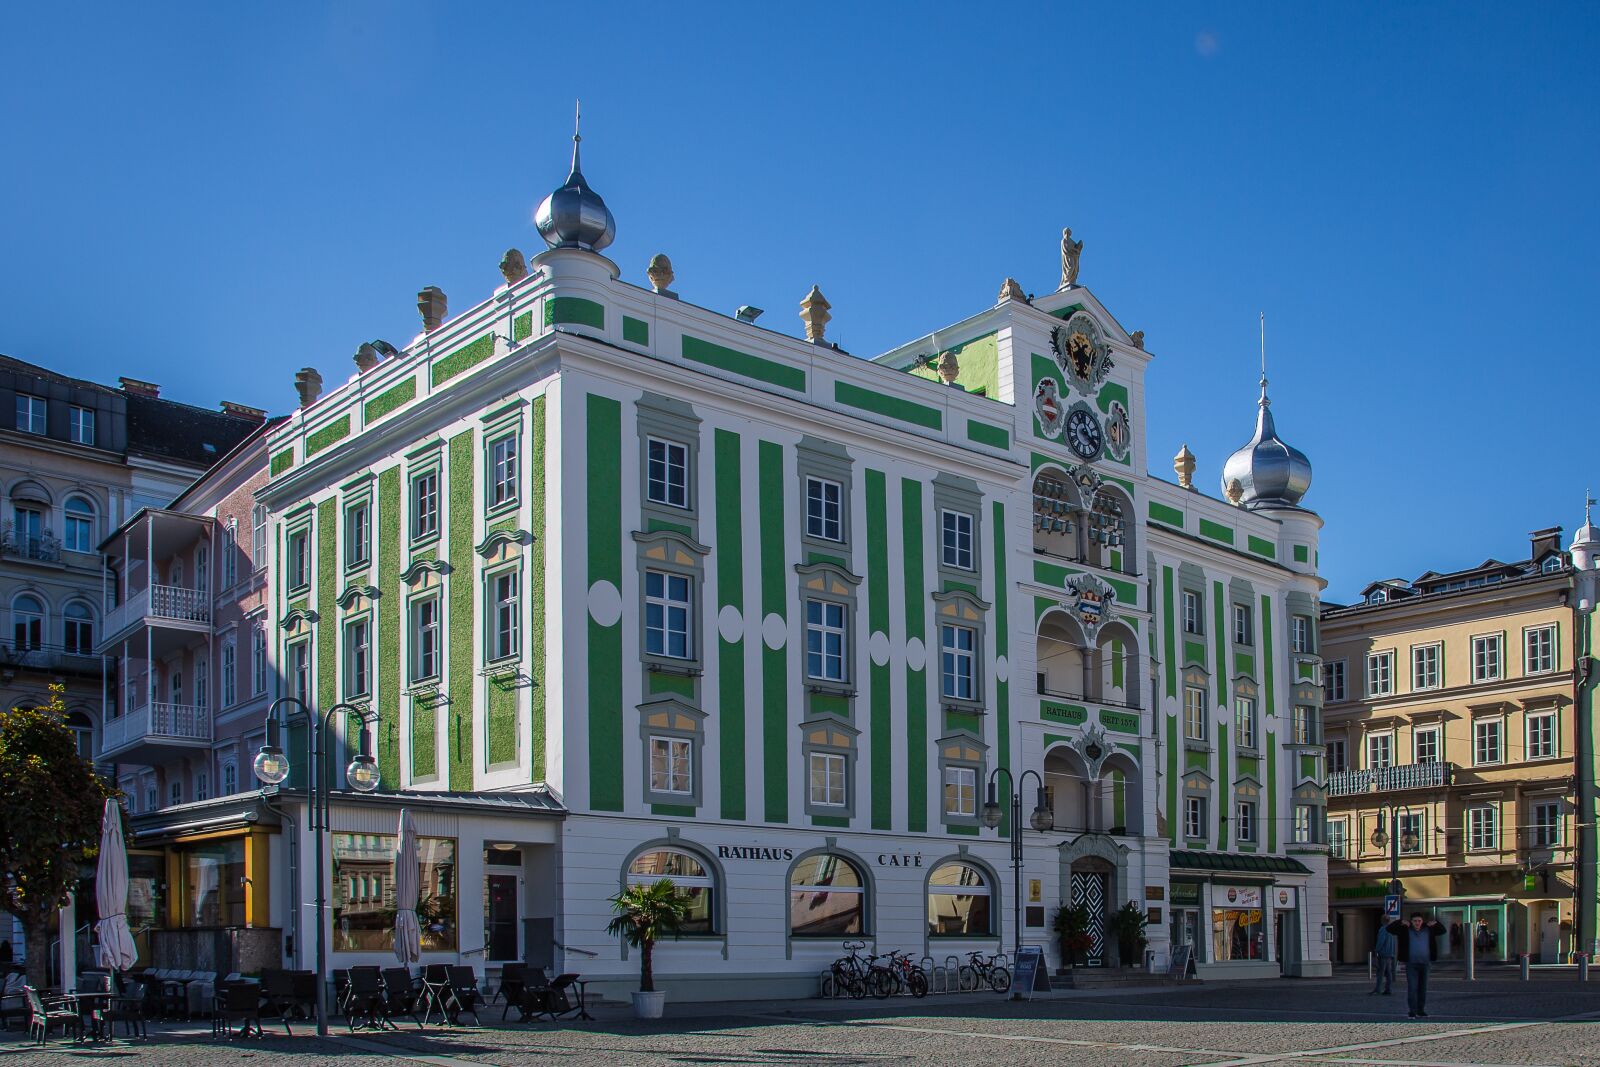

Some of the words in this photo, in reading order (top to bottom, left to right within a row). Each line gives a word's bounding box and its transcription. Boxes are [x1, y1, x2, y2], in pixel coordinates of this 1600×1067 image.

[1046, 707, 1082, 720] RATHAUS
[1102, 715, 1119, 725] SEIT
[718, 845, 793, 861] RATHAUS
[878, 852, 922, 867] CAFÉ
